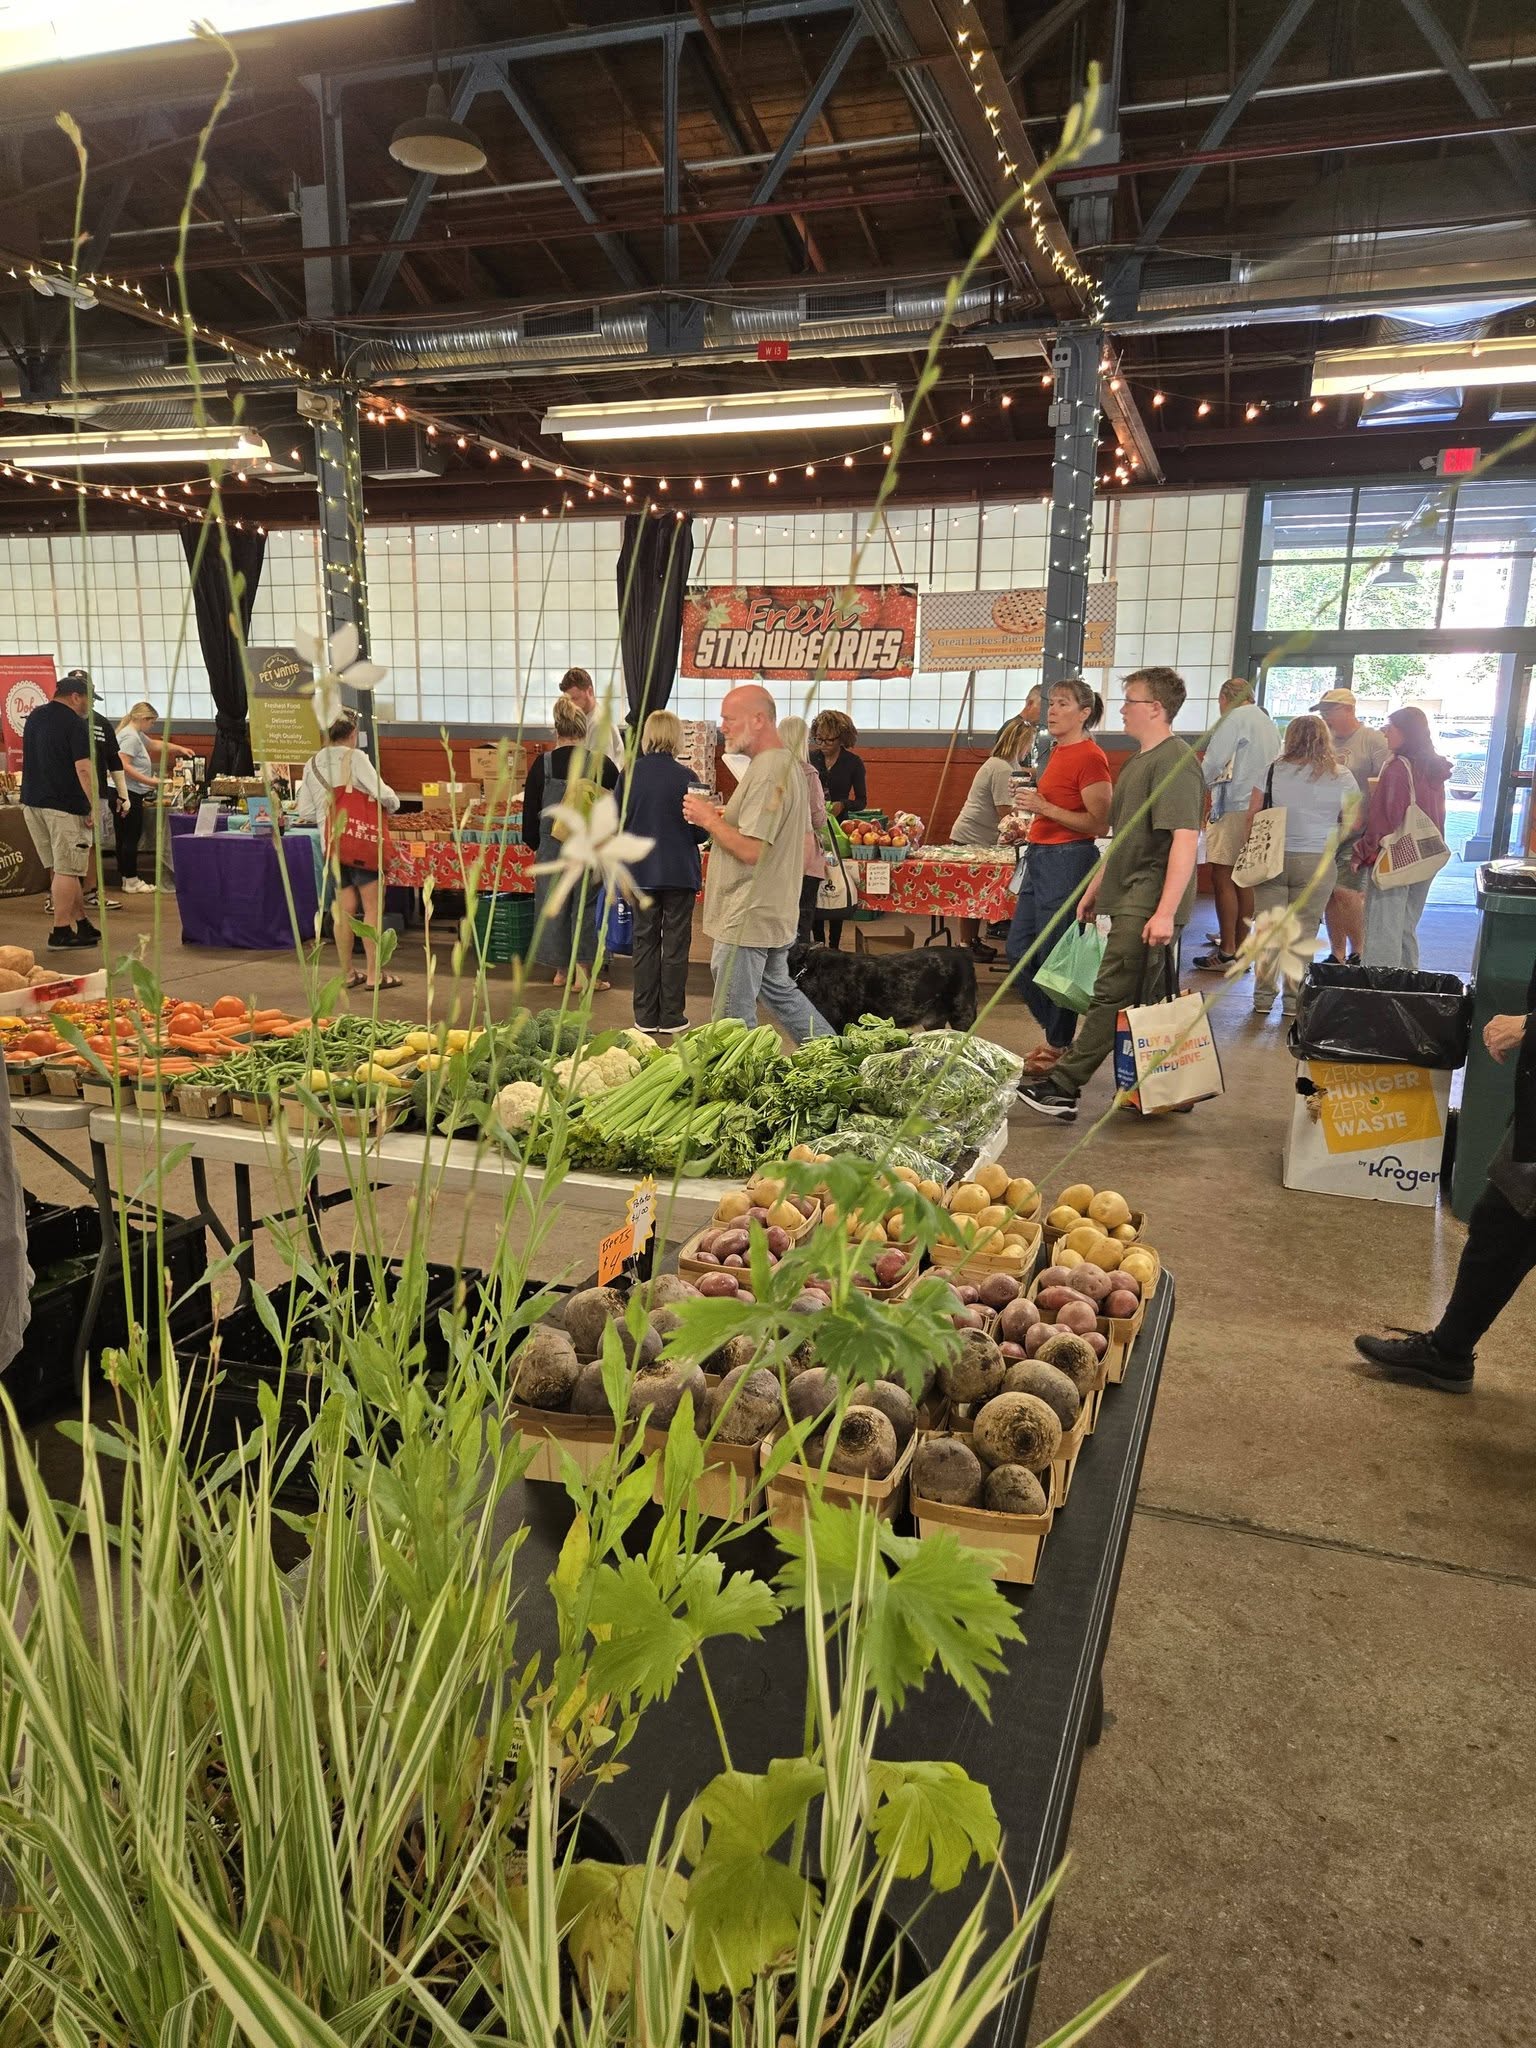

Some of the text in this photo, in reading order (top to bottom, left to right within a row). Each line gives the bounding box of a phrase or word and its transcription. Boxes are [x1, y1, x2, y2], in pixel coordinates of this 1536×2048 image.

[765, 346, 782, 356] W 13
[745, 597, 858, 635] Fresh
[694, 629, 903, 669] STRAWBERRIES
[937, 637, 965, 647] Great
[968, 635, 998, 646] Lakes
[1001, 635, 1018, 645] Pie
[259, 663, 300, 683] PET WANTS
[1138, 1036, 1161, 1049] BUY
[1321, 1064, 1377, 1084] ZERO
[1326, 1070, 1421, 1101] HUNGER
[1329, 1097, 1385, 1120] ZERO
[1333, 1111, 1408, 1137] WASTE
[1368, 1155, 1440, 1191] Kroger
[602, 1251, 622, 1275] $4
